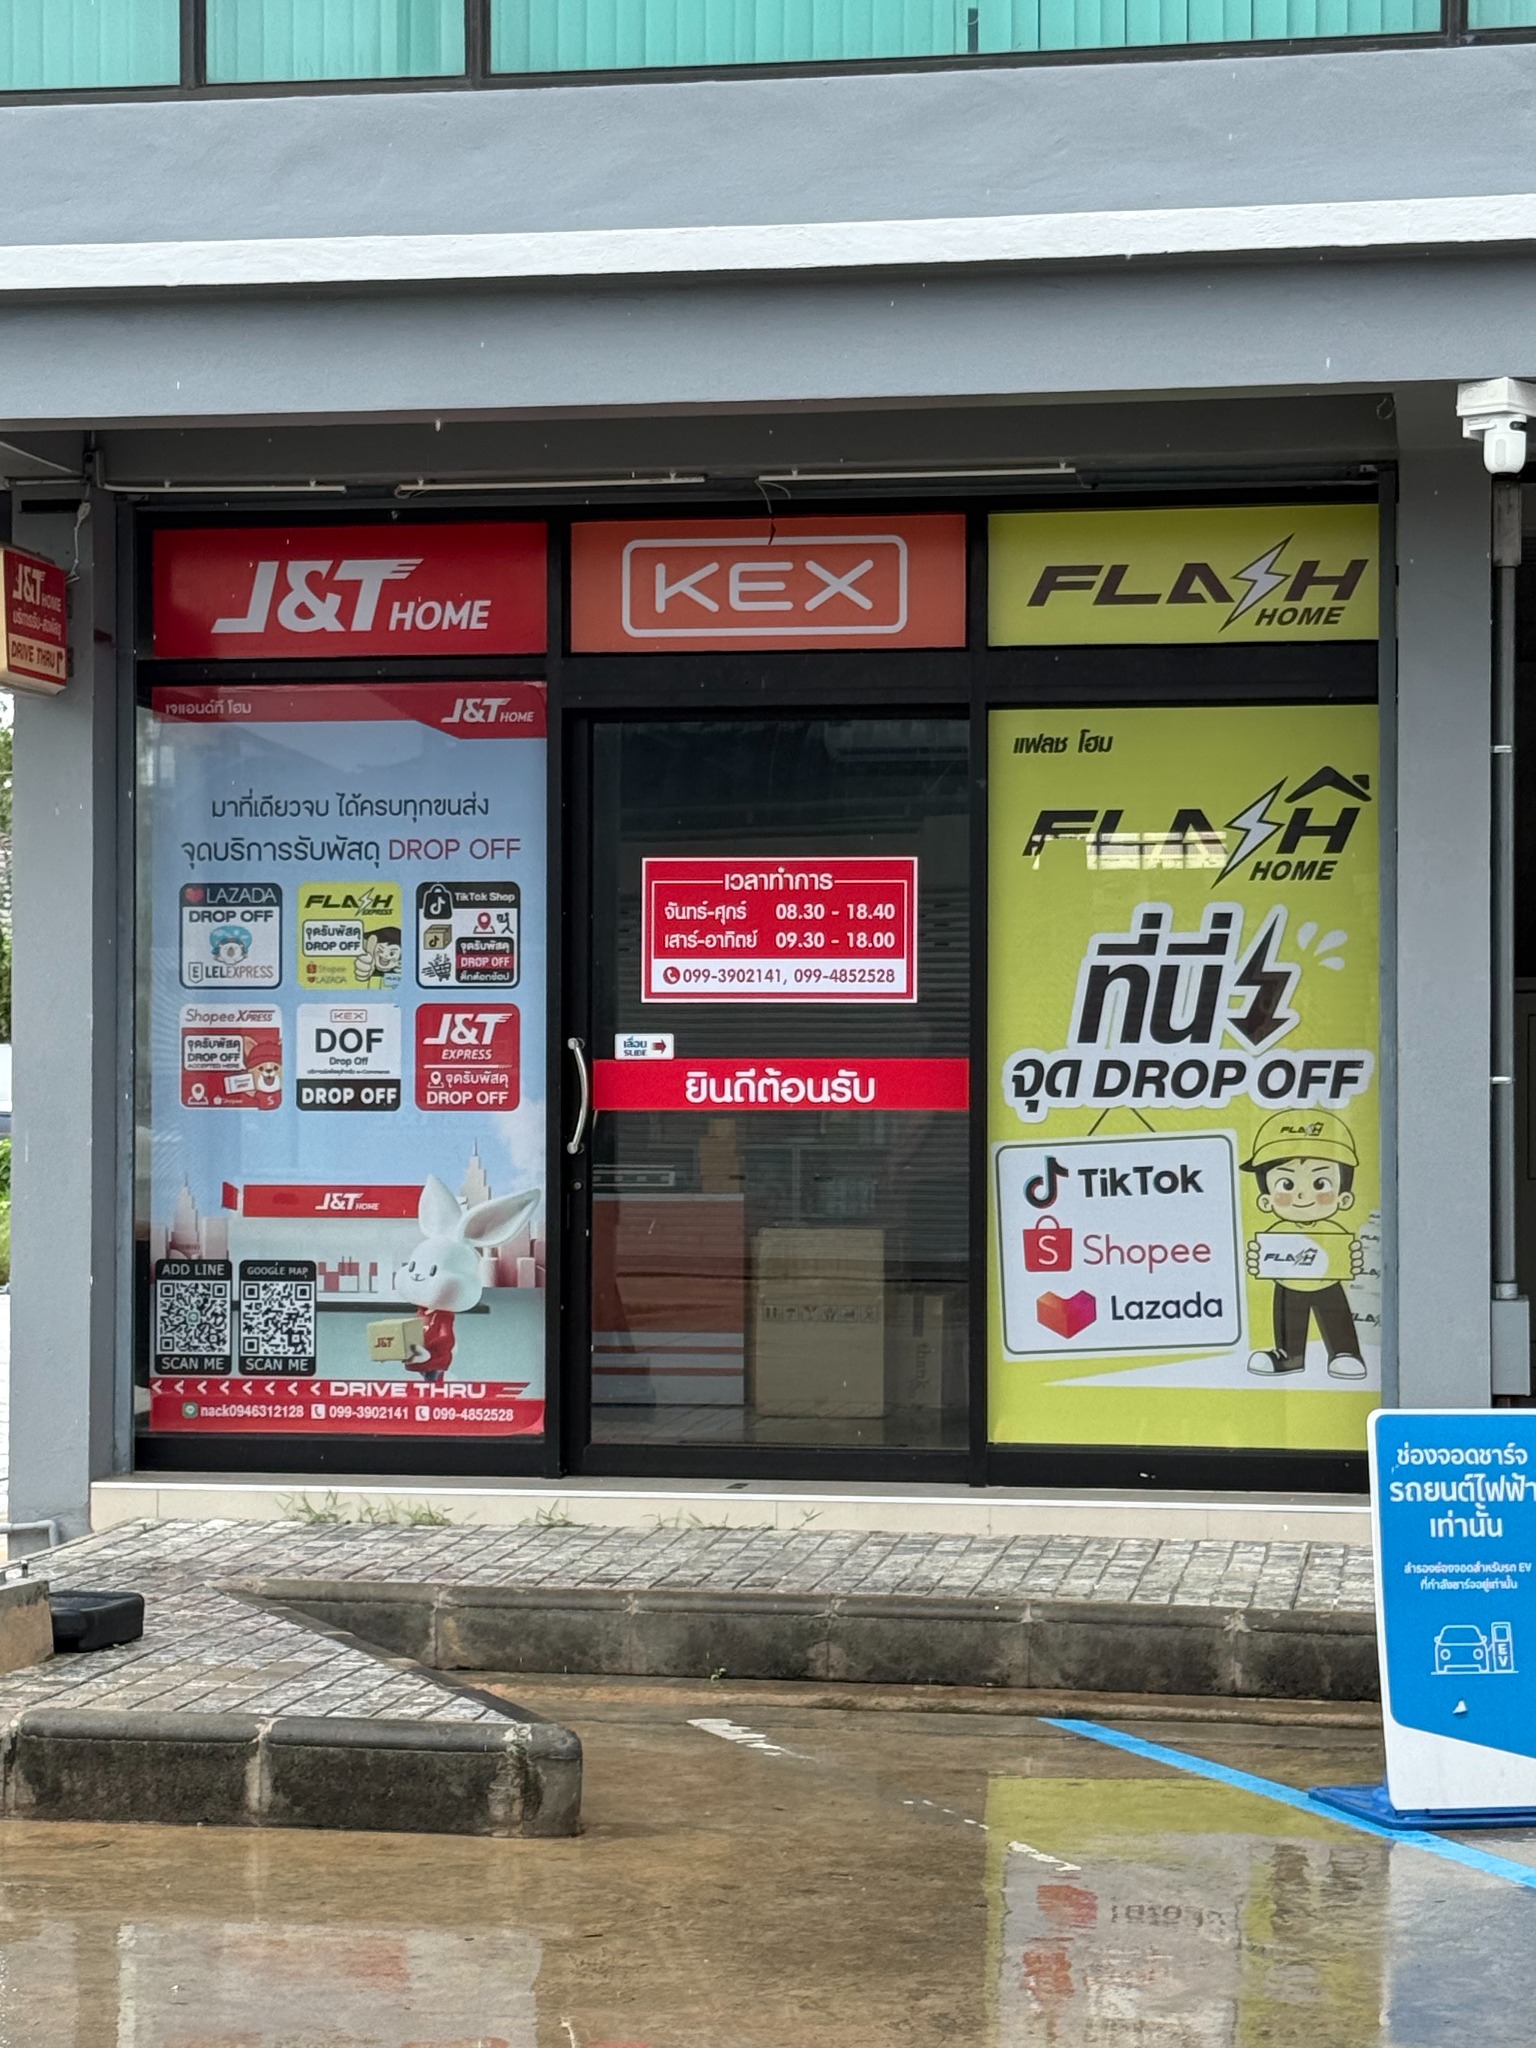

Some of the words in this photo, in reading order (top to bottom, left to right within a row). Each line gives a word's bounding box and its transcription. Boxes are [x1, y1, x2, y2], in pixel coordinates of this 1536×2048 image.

[12, 563, 46, 606] J&T
[654, 558, 875, 614] KEX
[1026, 532, 1369, 634] FLASH
[211, 558, 424, 634] J&T
[390, 599, 491, 632] HOME
[1254, 606, 1346, 627] HOME
[11, 640, 34, 663] DRIVE
[36, 648, 55, 669] THRU
[227, 699, 252, 715] โฮม
[441, 698, 512, 724] J&T
[500, 711, 534, 723] HOME
[1013, 733, 1069, 754] แฟลช
[1078, 729, 1114, 753] โฮม
[211, 789, 330, 818] มาที่เดียวจบ
[336, 791, 490, 823] ได้ครบทุกขนส่ง
[181, 834, 381, 869] จุดบริการรับพัสดุ
[388, 838, 460, 861] DROP
[469, 837, 522, 860] OFF
[724, 866, 834, 891] เวลาทำการ
[1249, 861, 1338, 882] HOME
[206, 887, 277, 904] LAZADA
[454, 892, 488, 902] TikTok
[489, 892, 516, 904] Shop
[189, 910, 237, 923] DROP
[240, 910, 274, 923] OFF
[361, 908, 395, 916] EXPRESS
[664, 900, 748, 926] จันทร์-ศุกร์
[775, 903, 826, 920] 08.30
[846, 903, 896, 920] 18.40
[305, 924, 361, 941] จุดรับพัสดุ
[664, 929, 758, 949] เสาร์-อาทิตย์
[775, 931, 826, 949] 09.30
[846, 931, 896, 949] 18.00
[305, 941, 337, 951] DROP
[339, 941, 361, 951] OFF
[460, 956, 489, 967] DROP
[491, 956, 510, 967] OFF
[682, 967, 789, 986] 099-3902141,
[794, 968, 896, 984] 099-4852528
[333, 1012, 364, 1020] KEX
[422, 1013, 514, 1045] J&T
[315, 1027, 384, 1053] DOF
[187, 1053, 217, 1062] DROP
[219, 1053, 241, 1062] OFF
[329, 1057, 352, 1067] Drop
[354, 1056, 369, 1066] Off
[441, 1048, 493, 1060] EXPRESS
[623, 1049, 647, 1057] SLIDE
[445, 1070, 509, 1089] จุดรับพัสดุ
[685, 1067, 876, 1104] ยินดีต้อนรับ
[1010, 1058, 1083, 1114] จุด
[1092, 1059, 1246, 1099] DROP
[1256, 1059, 1366, 1099] OFF
[301, 1087, 355, 1105] DROP
[360, 1087, 397, 1105] OFF
[426, 1091, 473, 1105] DROP
[476, 1091, 509, 1105] OFF
[1077, 1164, 1204, 1198] TikTok
[315, 1193, 364, 1210] J&T
[355, 1203, 380, 1211] HOME
[1083, 1234, 1212, 1273] Shopee
[161, 1264, 191, 1276] ADD
[195, 1264, 225, 1276] LINE
[247, 1266, 285, 1276] GOOGLE
[288, 1266, 309, 1276] MAP
[1110, 1292, 1223, 1321] Lazada
[161, 1357, 199, 1370] SCAN
[204, 1358, 225, 1370] ME
[246, 1358, 283, 1371] SCAN
[288, 1358, 309, 1371] ME
[330, 1382, 408, 1398] DRIVE
[413, 1383, 487, 1398] THRU
[200, 1404, 304, 1418] nack0946312128
[329, 1405, 409, 1420] 099-3902141
[432, 1407, 514, 1422] 099-4852528
[1396, 1441, 1529, 1466] ช่องจอดชาร์จ
[1389, 1472, 1536, 1503] รถยนต์ไฟฟ้า
[1429, 1502, 1504, 1538] เท่านั้น
[1519, 1562, 1532, 1573] EV
